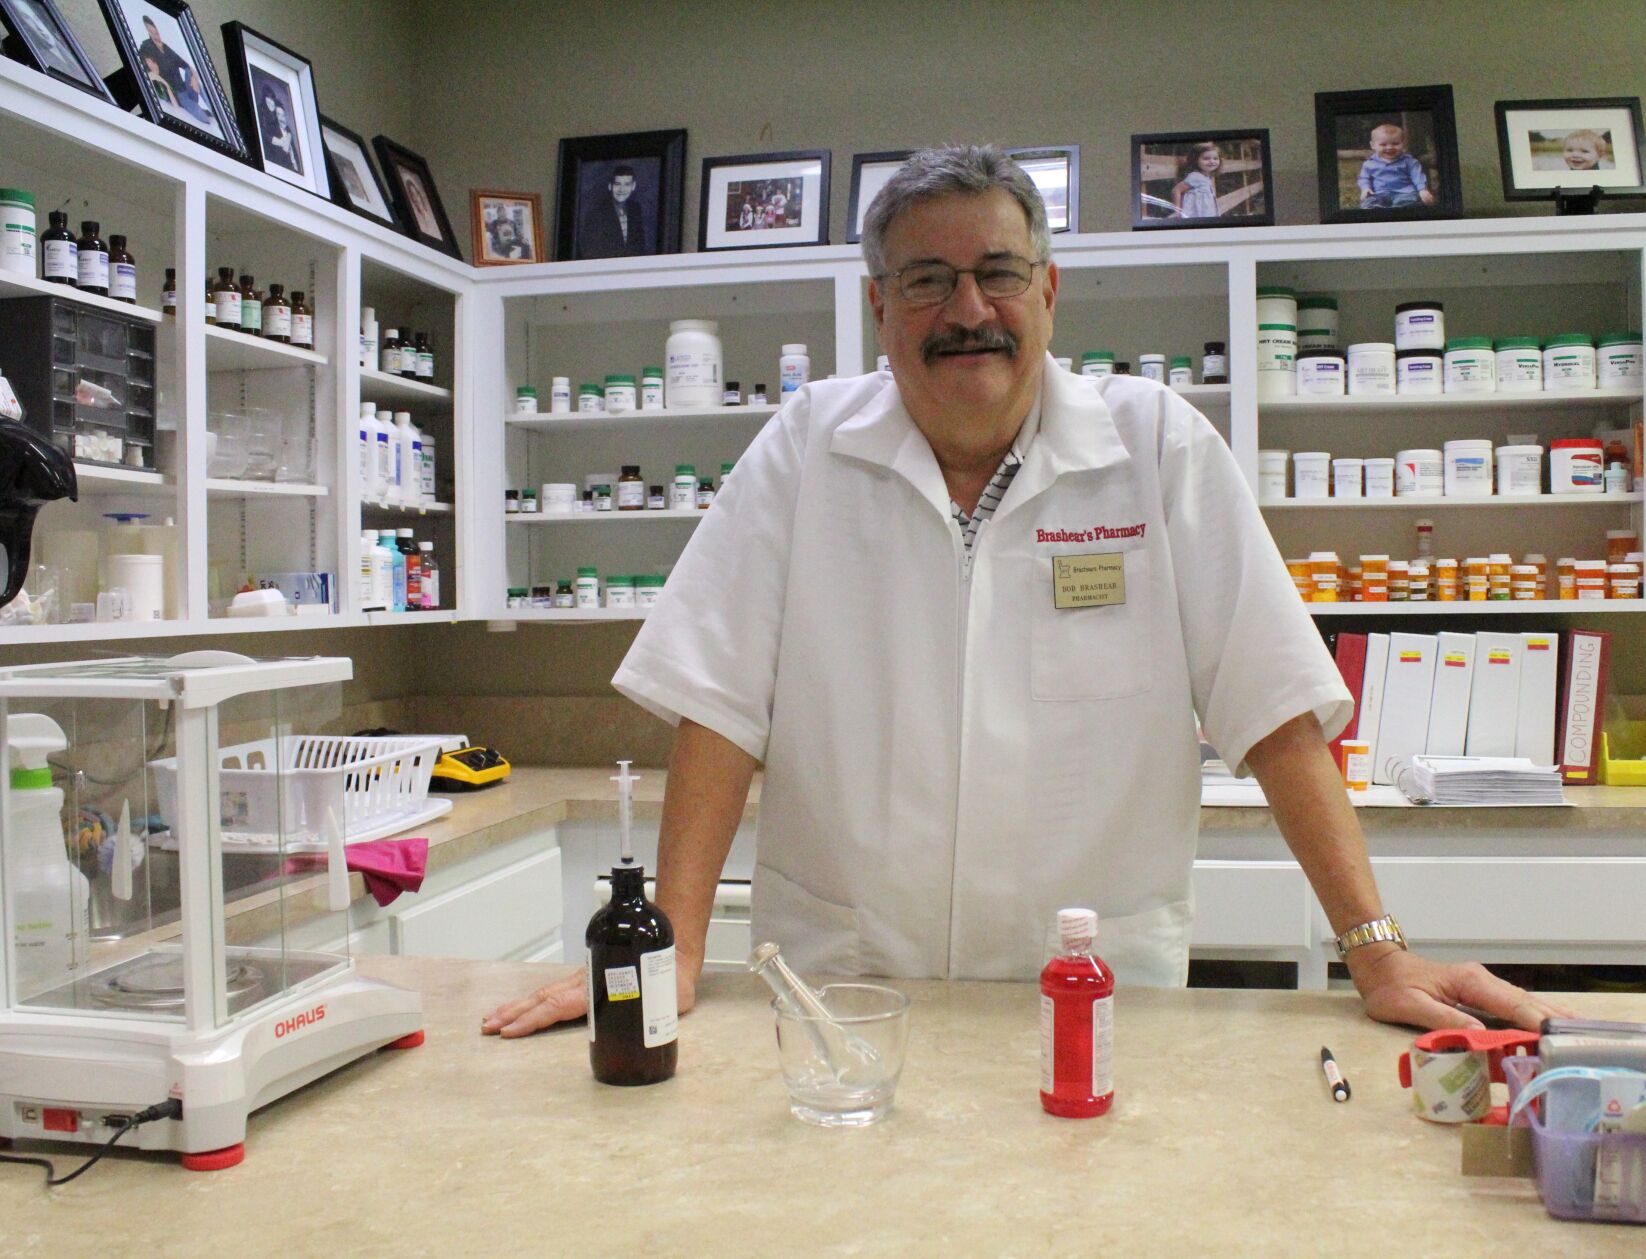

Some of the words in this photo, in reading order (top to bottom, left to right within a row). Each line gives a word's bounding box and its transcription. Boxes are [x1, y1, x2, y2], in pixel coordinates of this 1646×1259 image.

[1036, 528, 1093, 542] Brashear's
[1093, 523, 1146, 540] Pharmacy
[1569, 642, 1595, 763] COMPOUNDING
[275, 1004, 325, 1039] OHAUS
